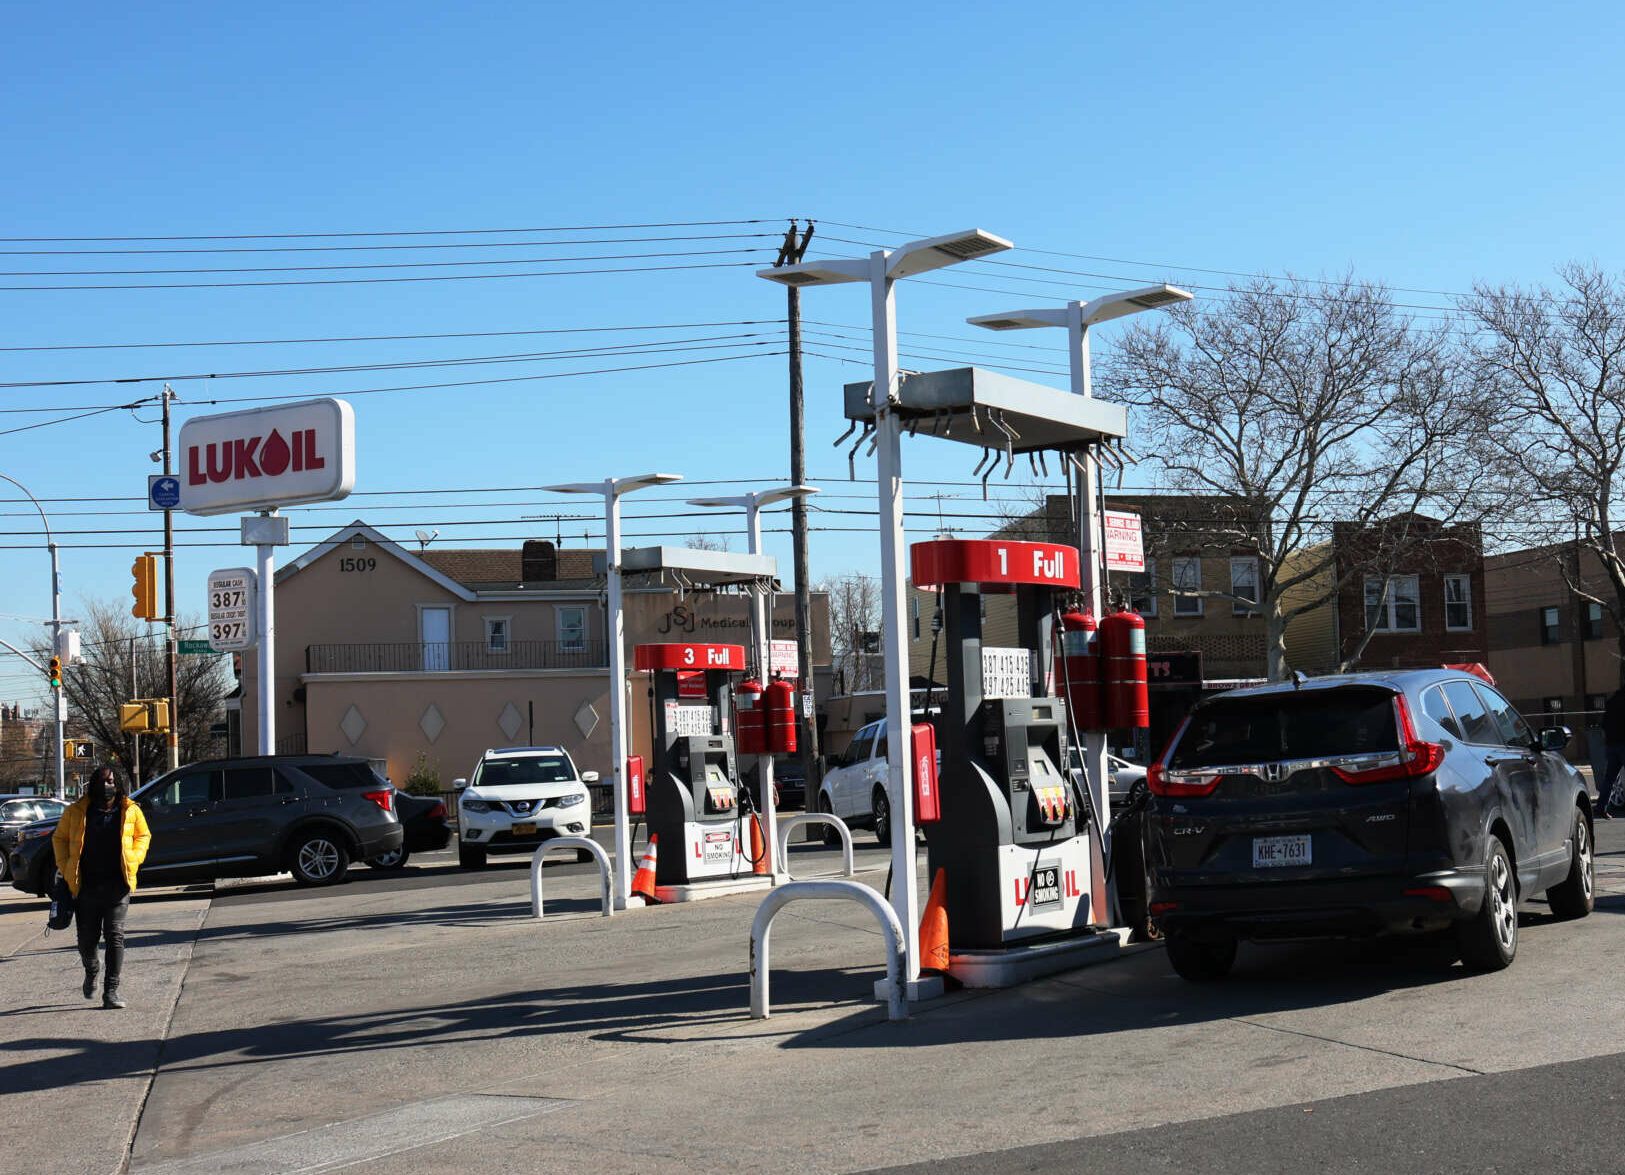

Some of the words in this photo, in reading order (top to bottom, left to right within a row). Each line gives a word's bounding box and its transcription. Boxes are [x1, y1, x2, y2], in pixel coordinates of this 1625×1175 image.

[189, 428, 325, 486] LUKOIL
[340, 557, 376, 572] 1509
[998, 549, 1008, 575] 1
[1033, 550, 1064, 579] Full
[213, 591, 240, 608] 387
[213, 623, 240, 639] 397
[772, 618, 796, 630] oup
[683, 647, 695, 665] 3
[707, 648, 730, 665] Full
[1147, 661, 1171, 677] TS
[1365, 814, 1396, 823] AWD
[1174, 826, 1206, 836] CR-V
[706, 851, 732, 860] SMOKING
[1283, 843, 1306, 859] 7631
[1036, 872, 1045, 888] NO
[1034, 886, 1059, 904] SMOKING
